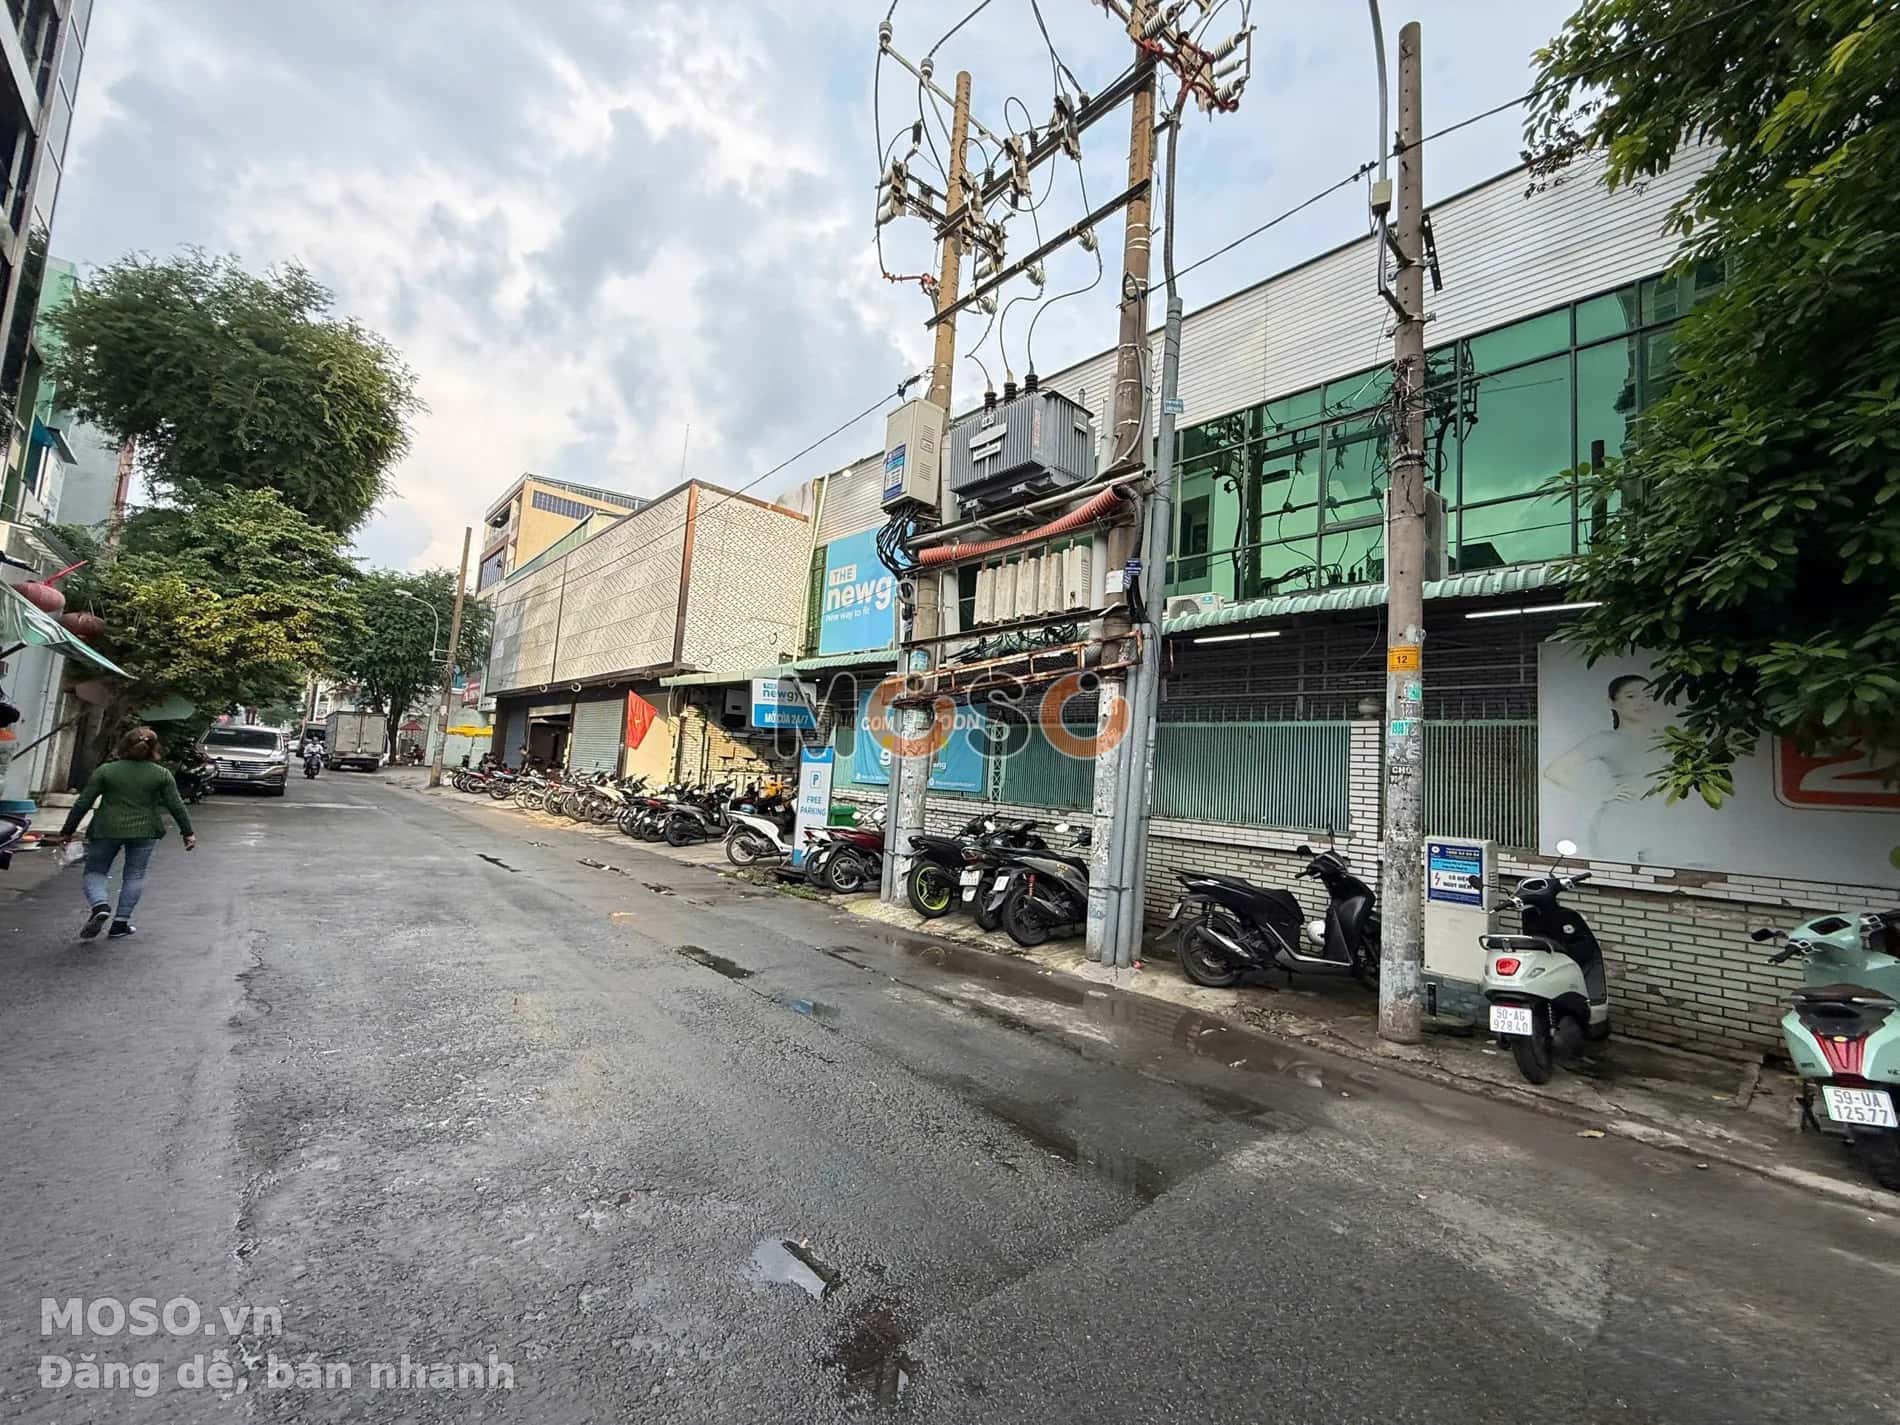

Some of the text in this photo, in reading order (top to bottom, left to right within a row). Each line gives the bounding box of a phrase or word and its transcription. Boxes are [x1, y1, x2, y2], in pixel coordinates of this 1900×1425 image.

[832, 567, 853, 583] THE
[826, 576, 893, 611] newg
[1397, 655, 1408, 664] 12
[807, 795, 823, 805] FREE
[800, 806, 826, 817] PARKING
[1833, 1089, 1882, 1108] 59-UA
[1834, 1105, 1888, 1124] 125.77
